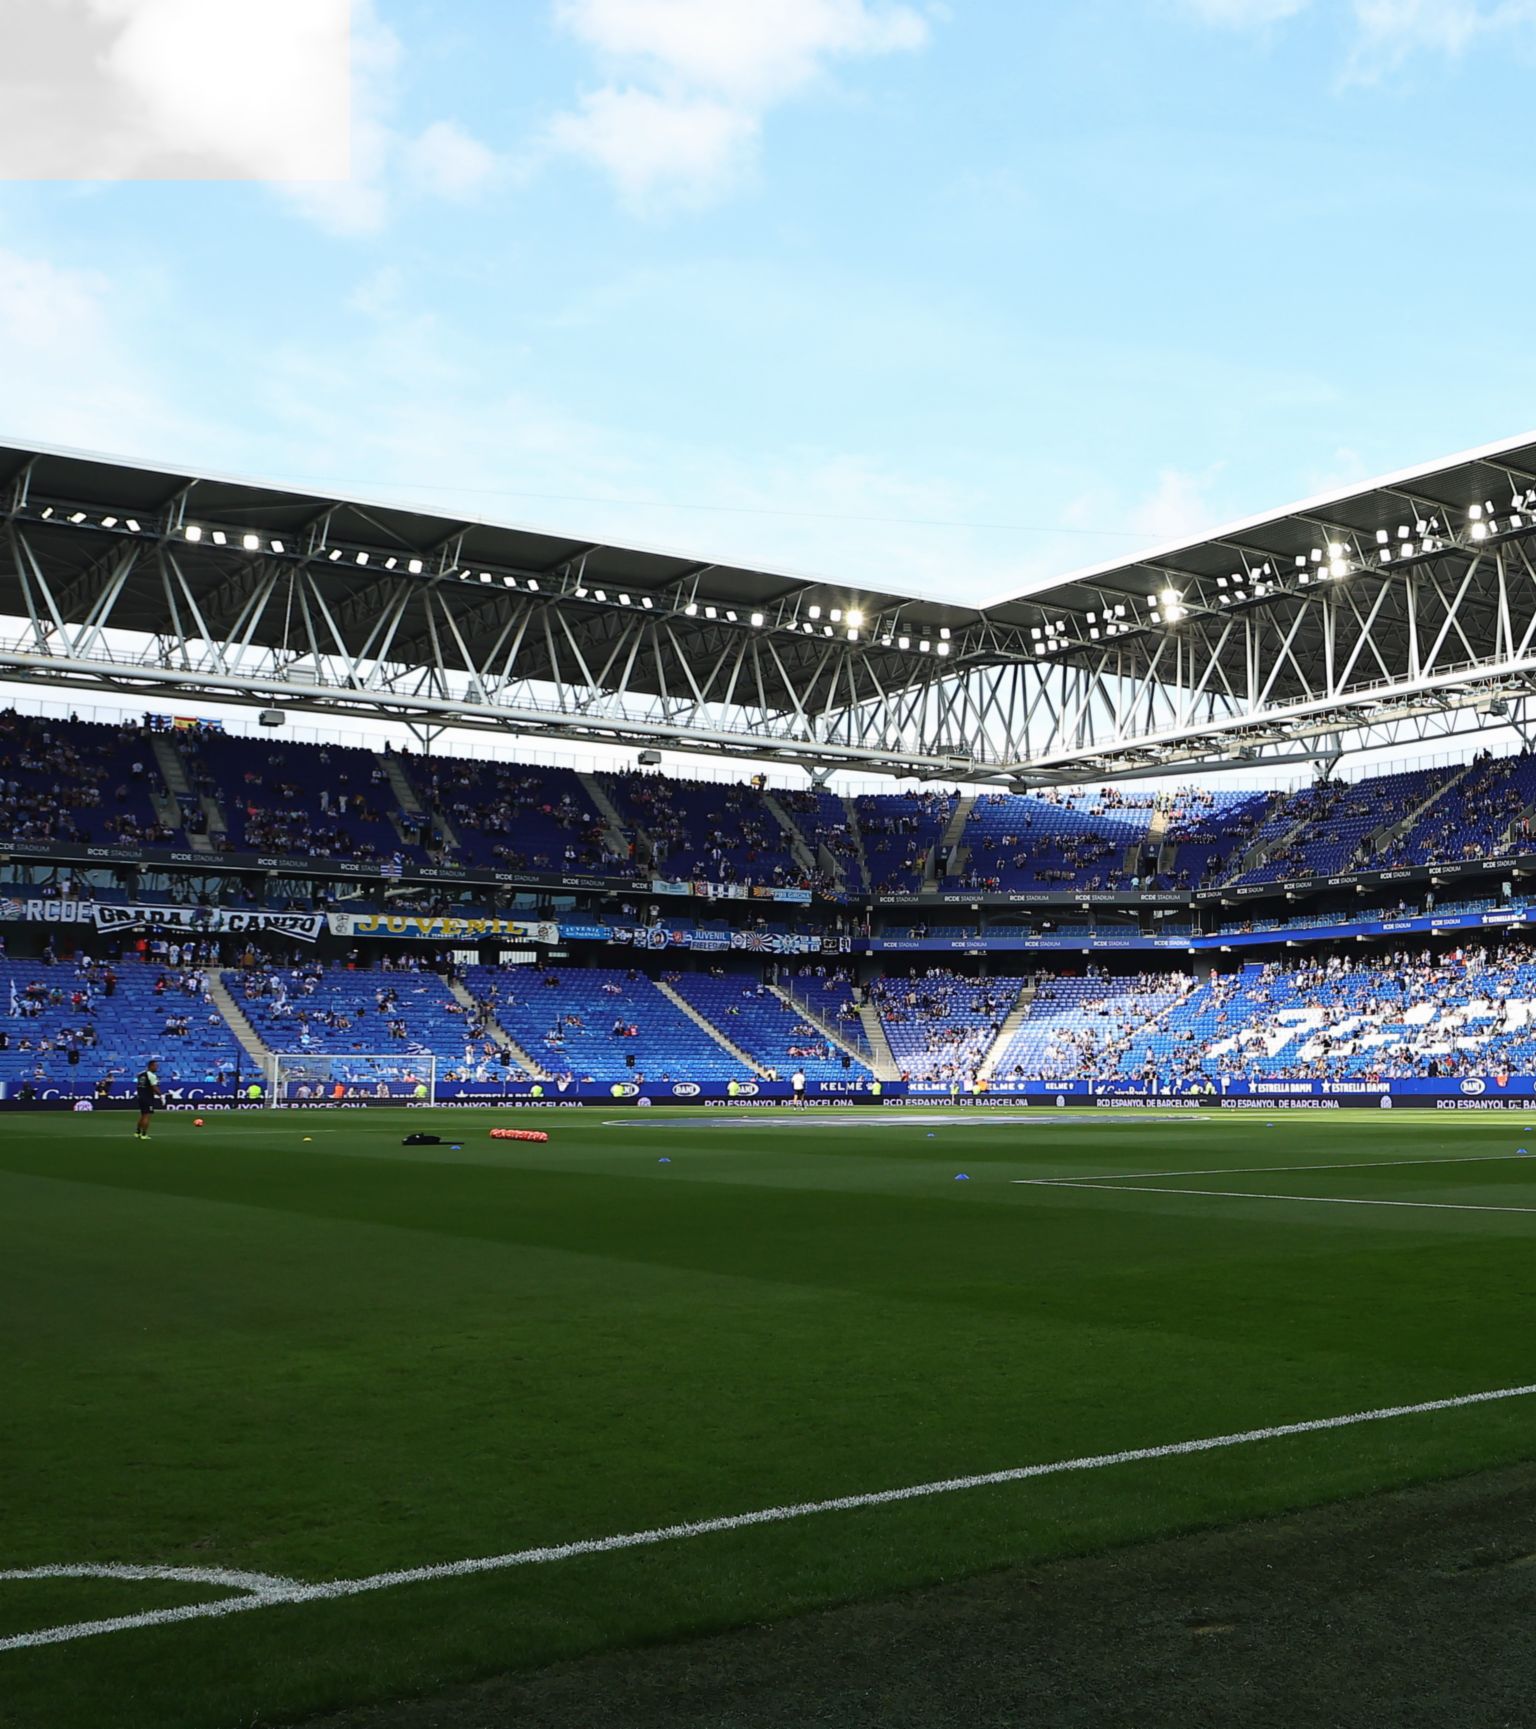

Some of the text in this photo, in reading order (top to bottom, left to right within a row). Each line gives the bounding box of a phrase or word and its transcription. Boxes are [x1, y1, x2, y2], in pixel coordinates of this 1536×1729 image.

[27, 900, 92, 923] RCDE
[359, 914, 523, 934] JUVENIL
[694, 930, 726, 940] JUVENIL
[676, 1086, 694, 1094] DANI
[820, 1082, 862, 1091] KELME
[1258, 1084, 1290, 1093] ESTRELLA
[1332, 1083, 1369, 1092] ESTRELLA
[1462, 1082, 1480, 1091] DANI
[1096, 1099, 1199, 1107] RCD ESPANYOL DE BARCELONA
[1221, 1099, 1339, 1108] RCD ESPANYOL DE BARCELONA
[1437, 1100, 1455, 1109] RCD
[1458, 1100, 1506, 1109] ESPANYOL
